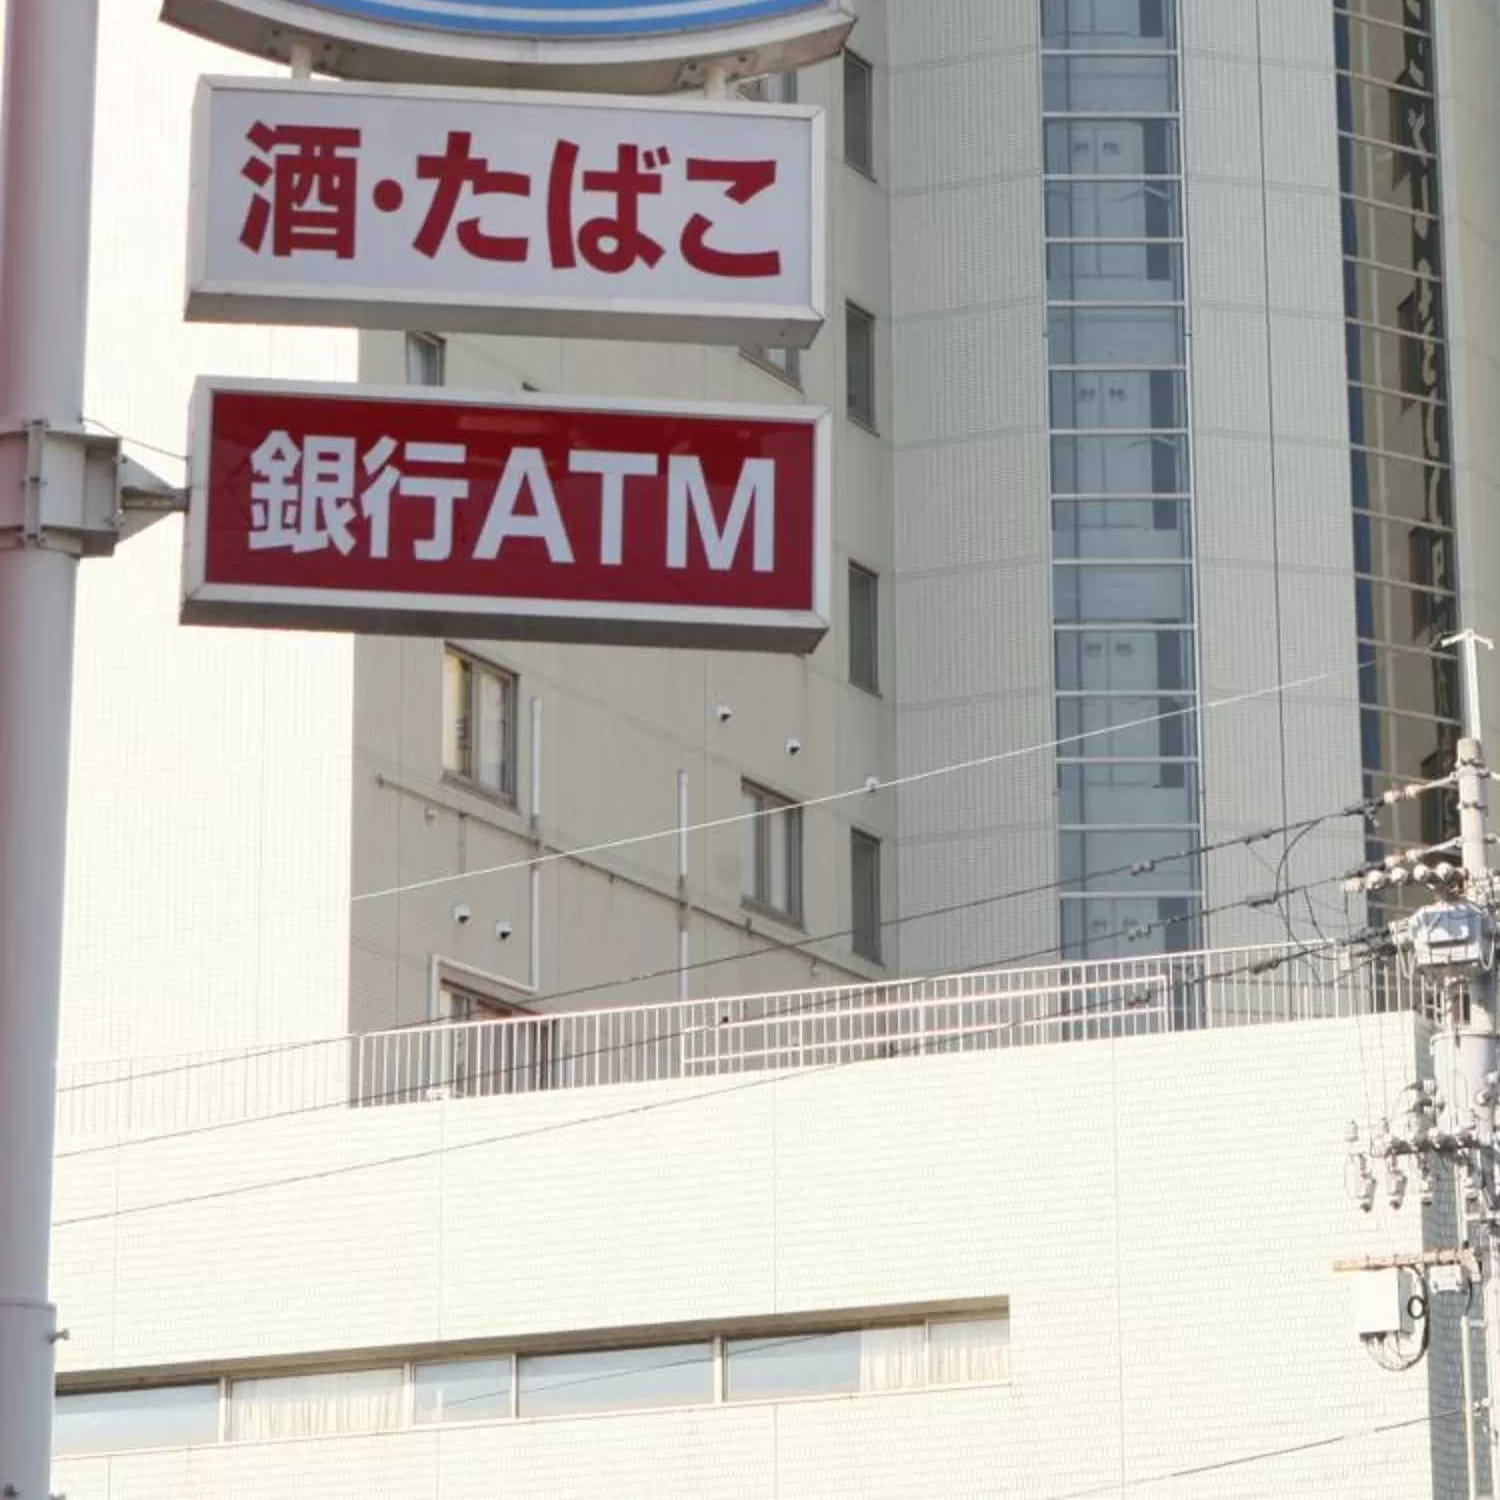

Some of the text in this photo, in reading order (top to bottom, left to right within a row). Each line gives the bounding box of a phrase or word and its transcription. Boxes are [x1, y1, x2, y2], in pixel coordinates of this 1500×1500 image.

[239, 120, 782, 278] 酒・たばこ
[248, 429, 776, 573] 銀行ATM
